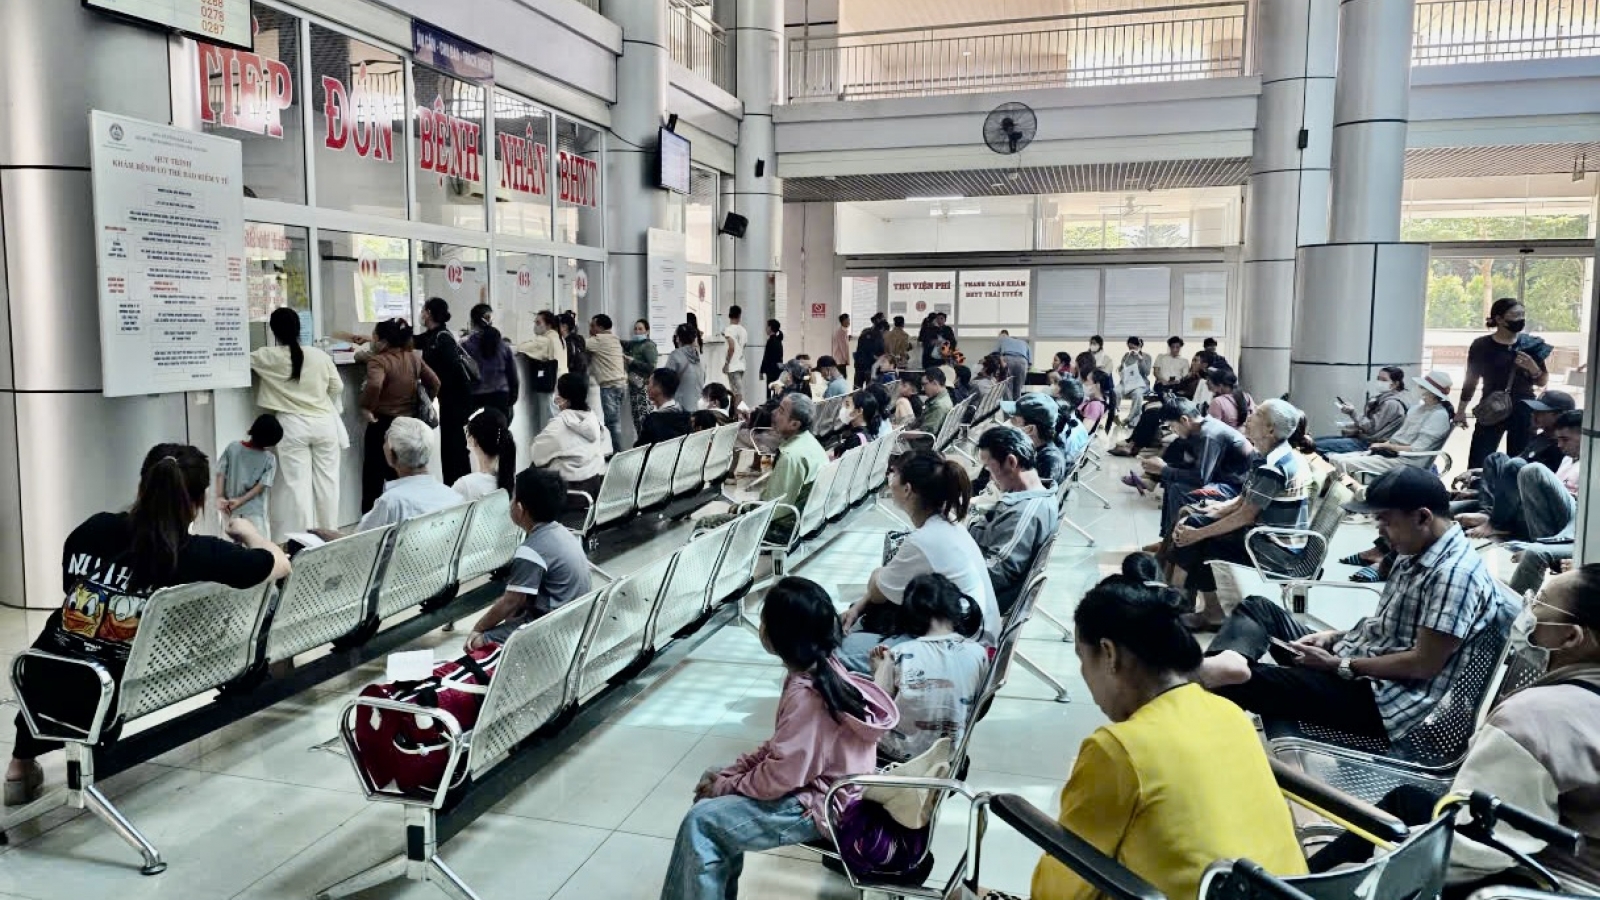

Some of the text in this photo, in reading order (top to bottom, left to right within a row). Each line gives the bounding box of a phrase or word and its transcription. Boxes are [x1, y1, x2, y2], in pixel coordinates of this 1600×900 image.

[420, 94, 480, 188] BỆNH
[500, 122, 547, 195] NHÂN
[559, 151, 597, 207] BHYT
[361, 259, 378, 277] 01
[446, 267, 463, 284] 02
[518, 272, 531, 288] 03
[574, 276, 587, 291] 04
[893, 281, 951, 292] THU VIỆN PHÍ
